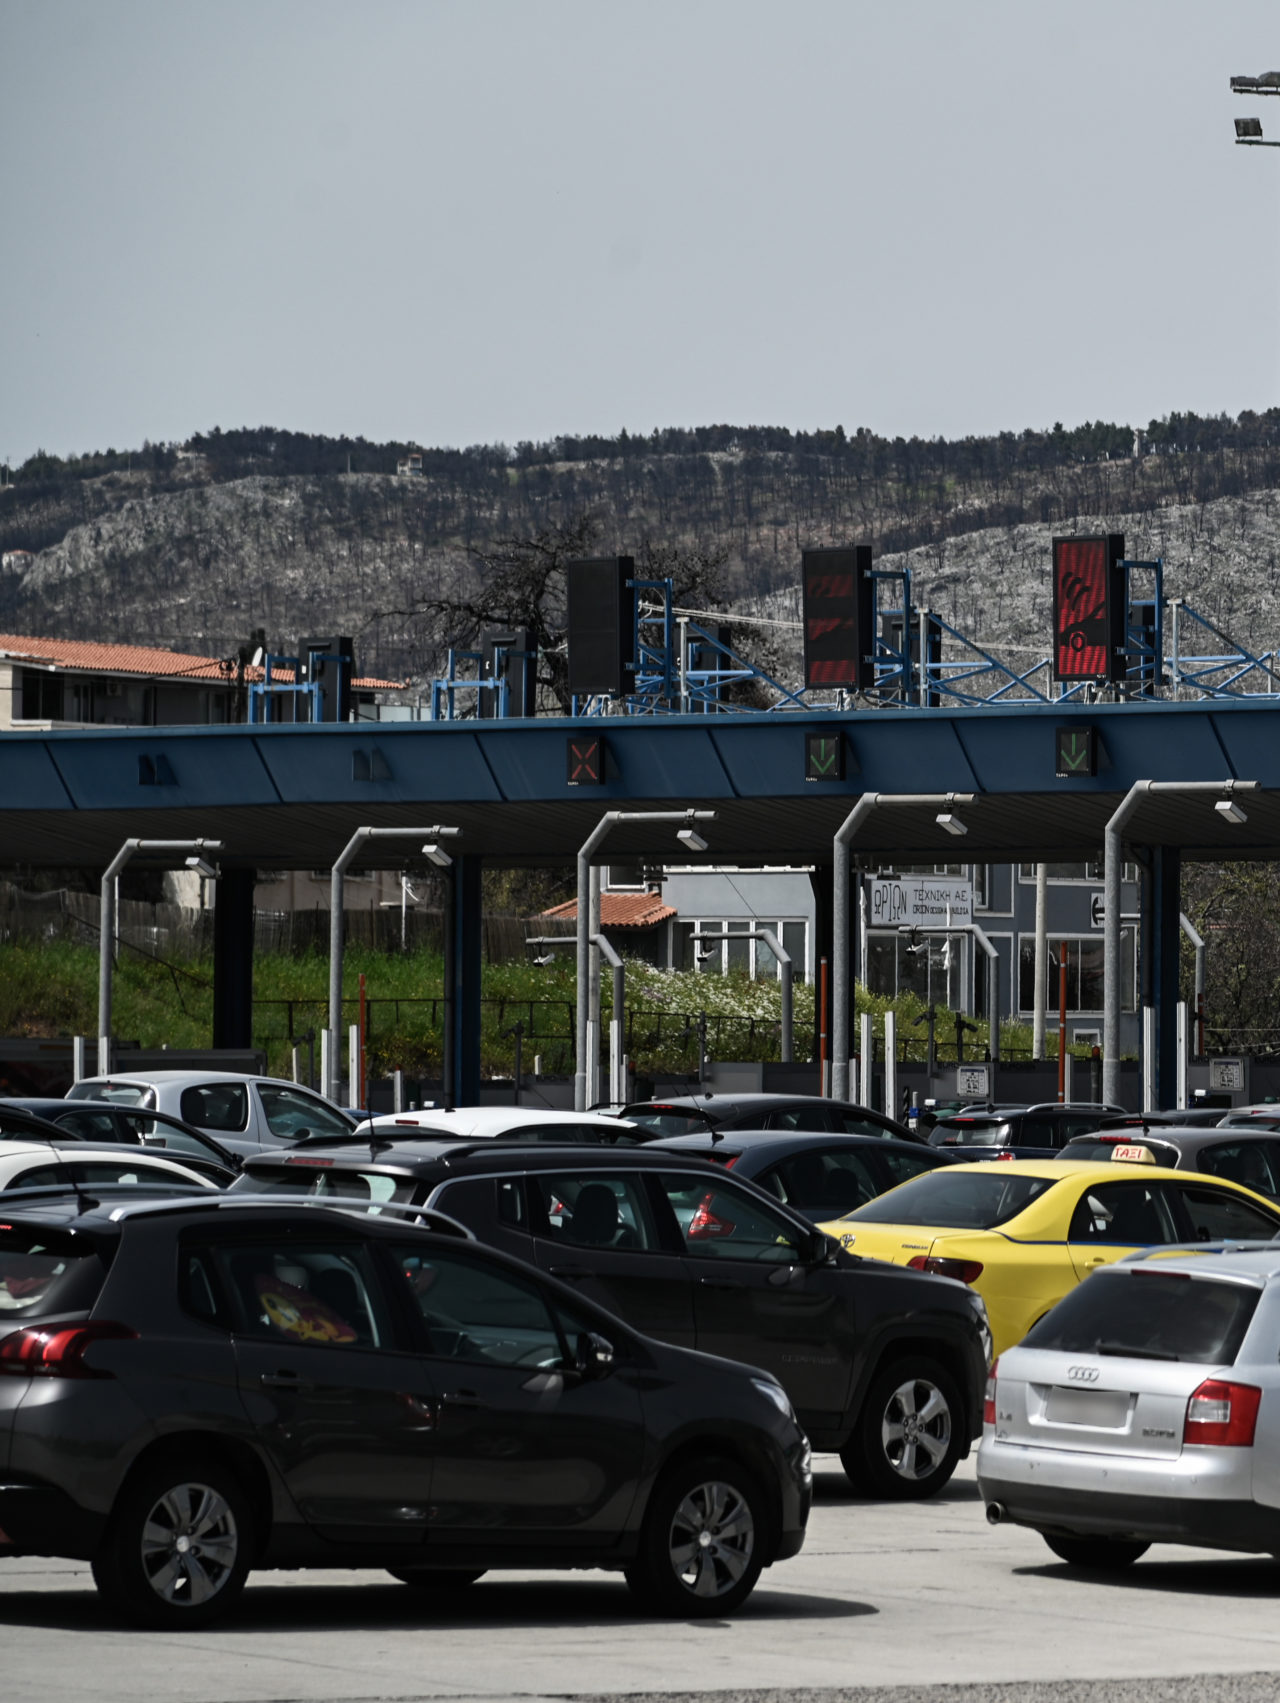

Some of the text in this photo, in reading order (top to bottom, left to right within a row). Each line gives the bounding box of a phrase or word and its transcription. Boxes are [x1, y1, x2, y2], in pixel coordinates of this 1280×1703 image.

[913, 889, 968, 902] ΤΕΧΝΙΚΗ ΑΕ
[1116, 1148, 1142, 1158] ΤΑΞΙ
